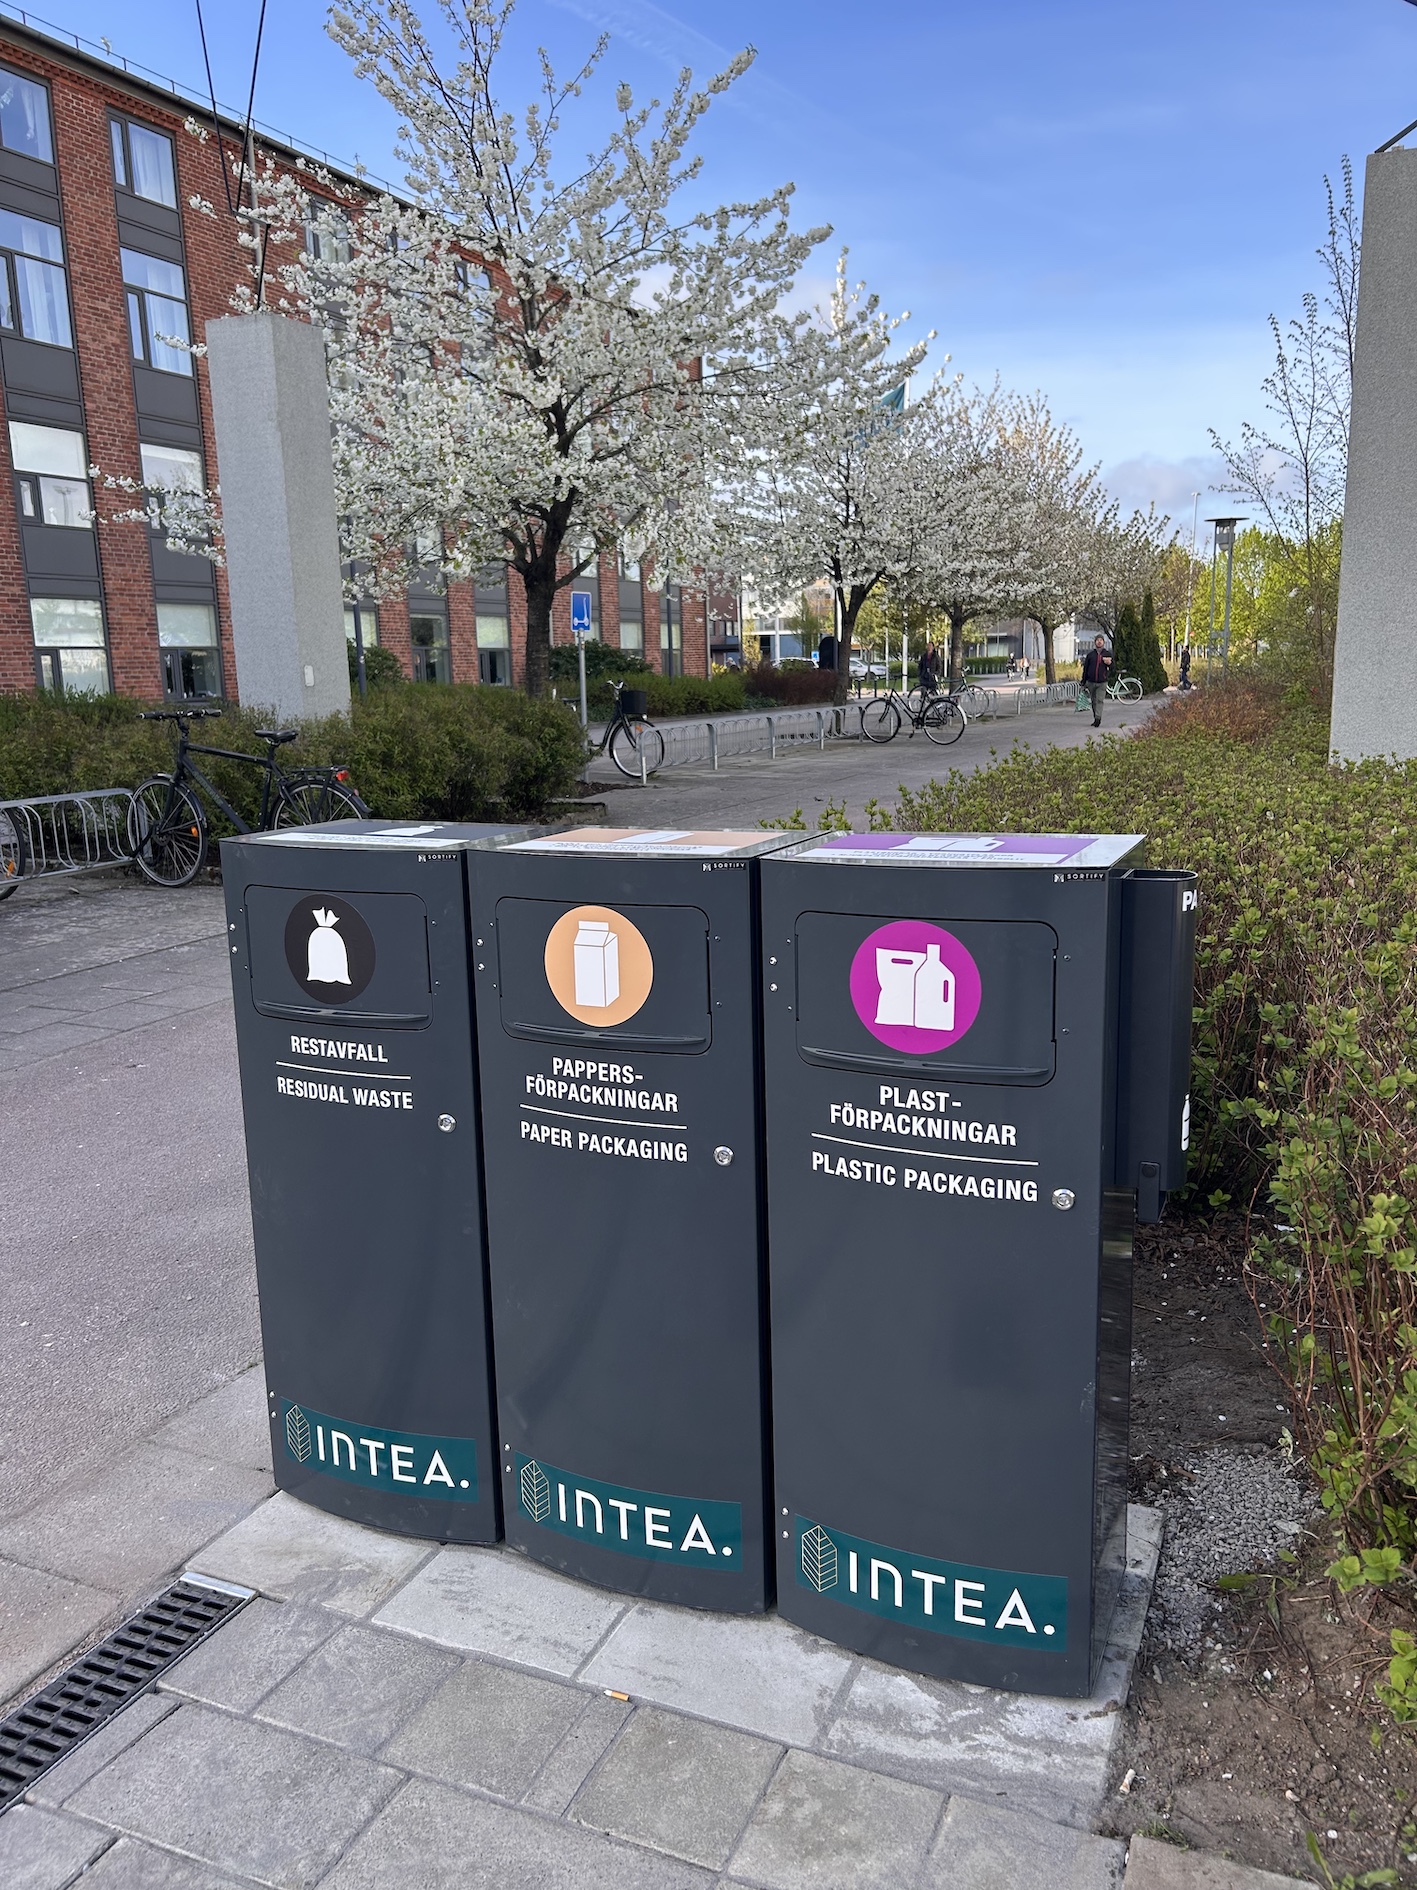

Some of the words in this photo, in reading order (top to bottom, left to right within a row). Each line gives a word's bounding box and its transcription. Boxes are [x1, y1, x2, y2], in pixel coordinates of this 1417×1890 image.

[290, 1035, 389, 1063] RESTAVFALL
[552, 1056, 644, 1085] PAPPERS-
[276, 1076, 349, 1104] RESIDUAL
[352, 1087, 414, 1110] WASTE
[525, 1074, 679, 1113] FÖRPACKNINGAR
[879, 1085, 962, 1113] PLAST-
[520, 1120, 573, 1148] PAPER
[578, 1131, 688, 1163] PACKAGING
[830, 1103, 1017, 1147] FÖRPACKNINGAR
[811, 1151, 897, 1186] PLASTIC
[903, 1168, 1039, 1202] PACKAGING
